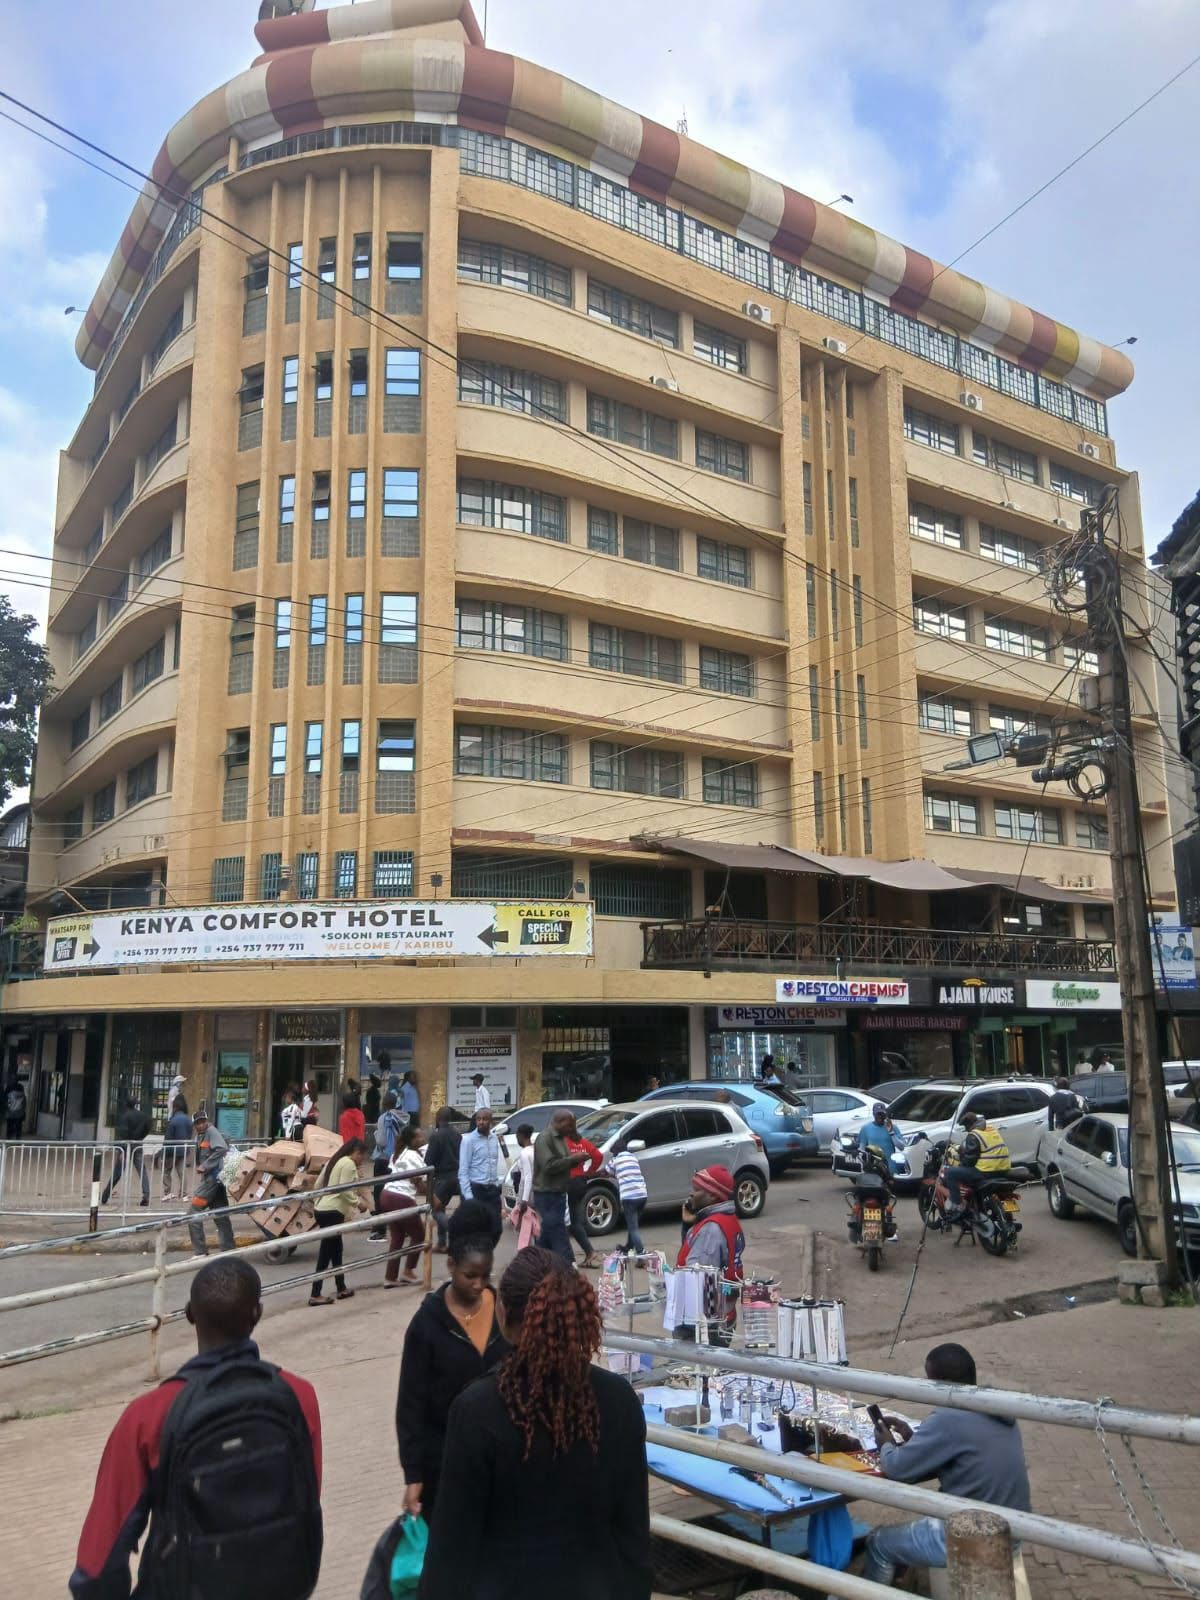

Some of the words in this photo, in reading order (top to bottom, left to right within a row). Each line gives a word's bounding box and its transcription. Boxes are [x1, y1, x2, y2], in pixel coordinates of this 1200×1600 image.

[518, 909, 546, 917] CALL
[550, 910, 570, 918] FOR
[121, 916, 194, 935] KENYA
[203, 911, 337, 931] COMFORT
[347, 909, 443, 927] HOTEL
[50, 924, 76, 935] WHATSAPP
[78, 924, 90, 932] FOR
[527, 922, 565, 934] SPECIAL
[321, 932, 372, 940] +SOKONI
[376, 931, 454, 939] RESTAURANT
[532, 933, 560, 943] OFFER
[243, 944, 261, 952] 737
[265, 943, 284, 951] 777
[288, 943, 304, 951] 711
[325, 942, 390, 950] WELCOME
[404, 941, 453, 949] KARIBU
[123, 949, 142, 957] +254
[144, 948, 159, 956] 737
[162, 947, 178, 955] 777
[181, 946, 197, 954] 777
[797, 982, 848, 996] RESTON
[850, 983, 907, 998] CHEMIST
[939, 986, 975, 1004] AJANI
[979, 986, 1014, 1004] HOUSE
[736, 1007, 785, 1020] RESTON
[787, 1007, 842, 1019] CHEMIST
[280, 1015, 337, 1024] MOMBASA
[866, 1016, 893, 1028] AJANI
[896, 1017, 925, 1028] HOUSE
[928, 1018, 962, 1029] BAKERY
[287, 1026, 326, 1036] HOUSE
[458, 1047, 478, 1055] KENYA
[480, 1047, 509, 1055] COMFORT
